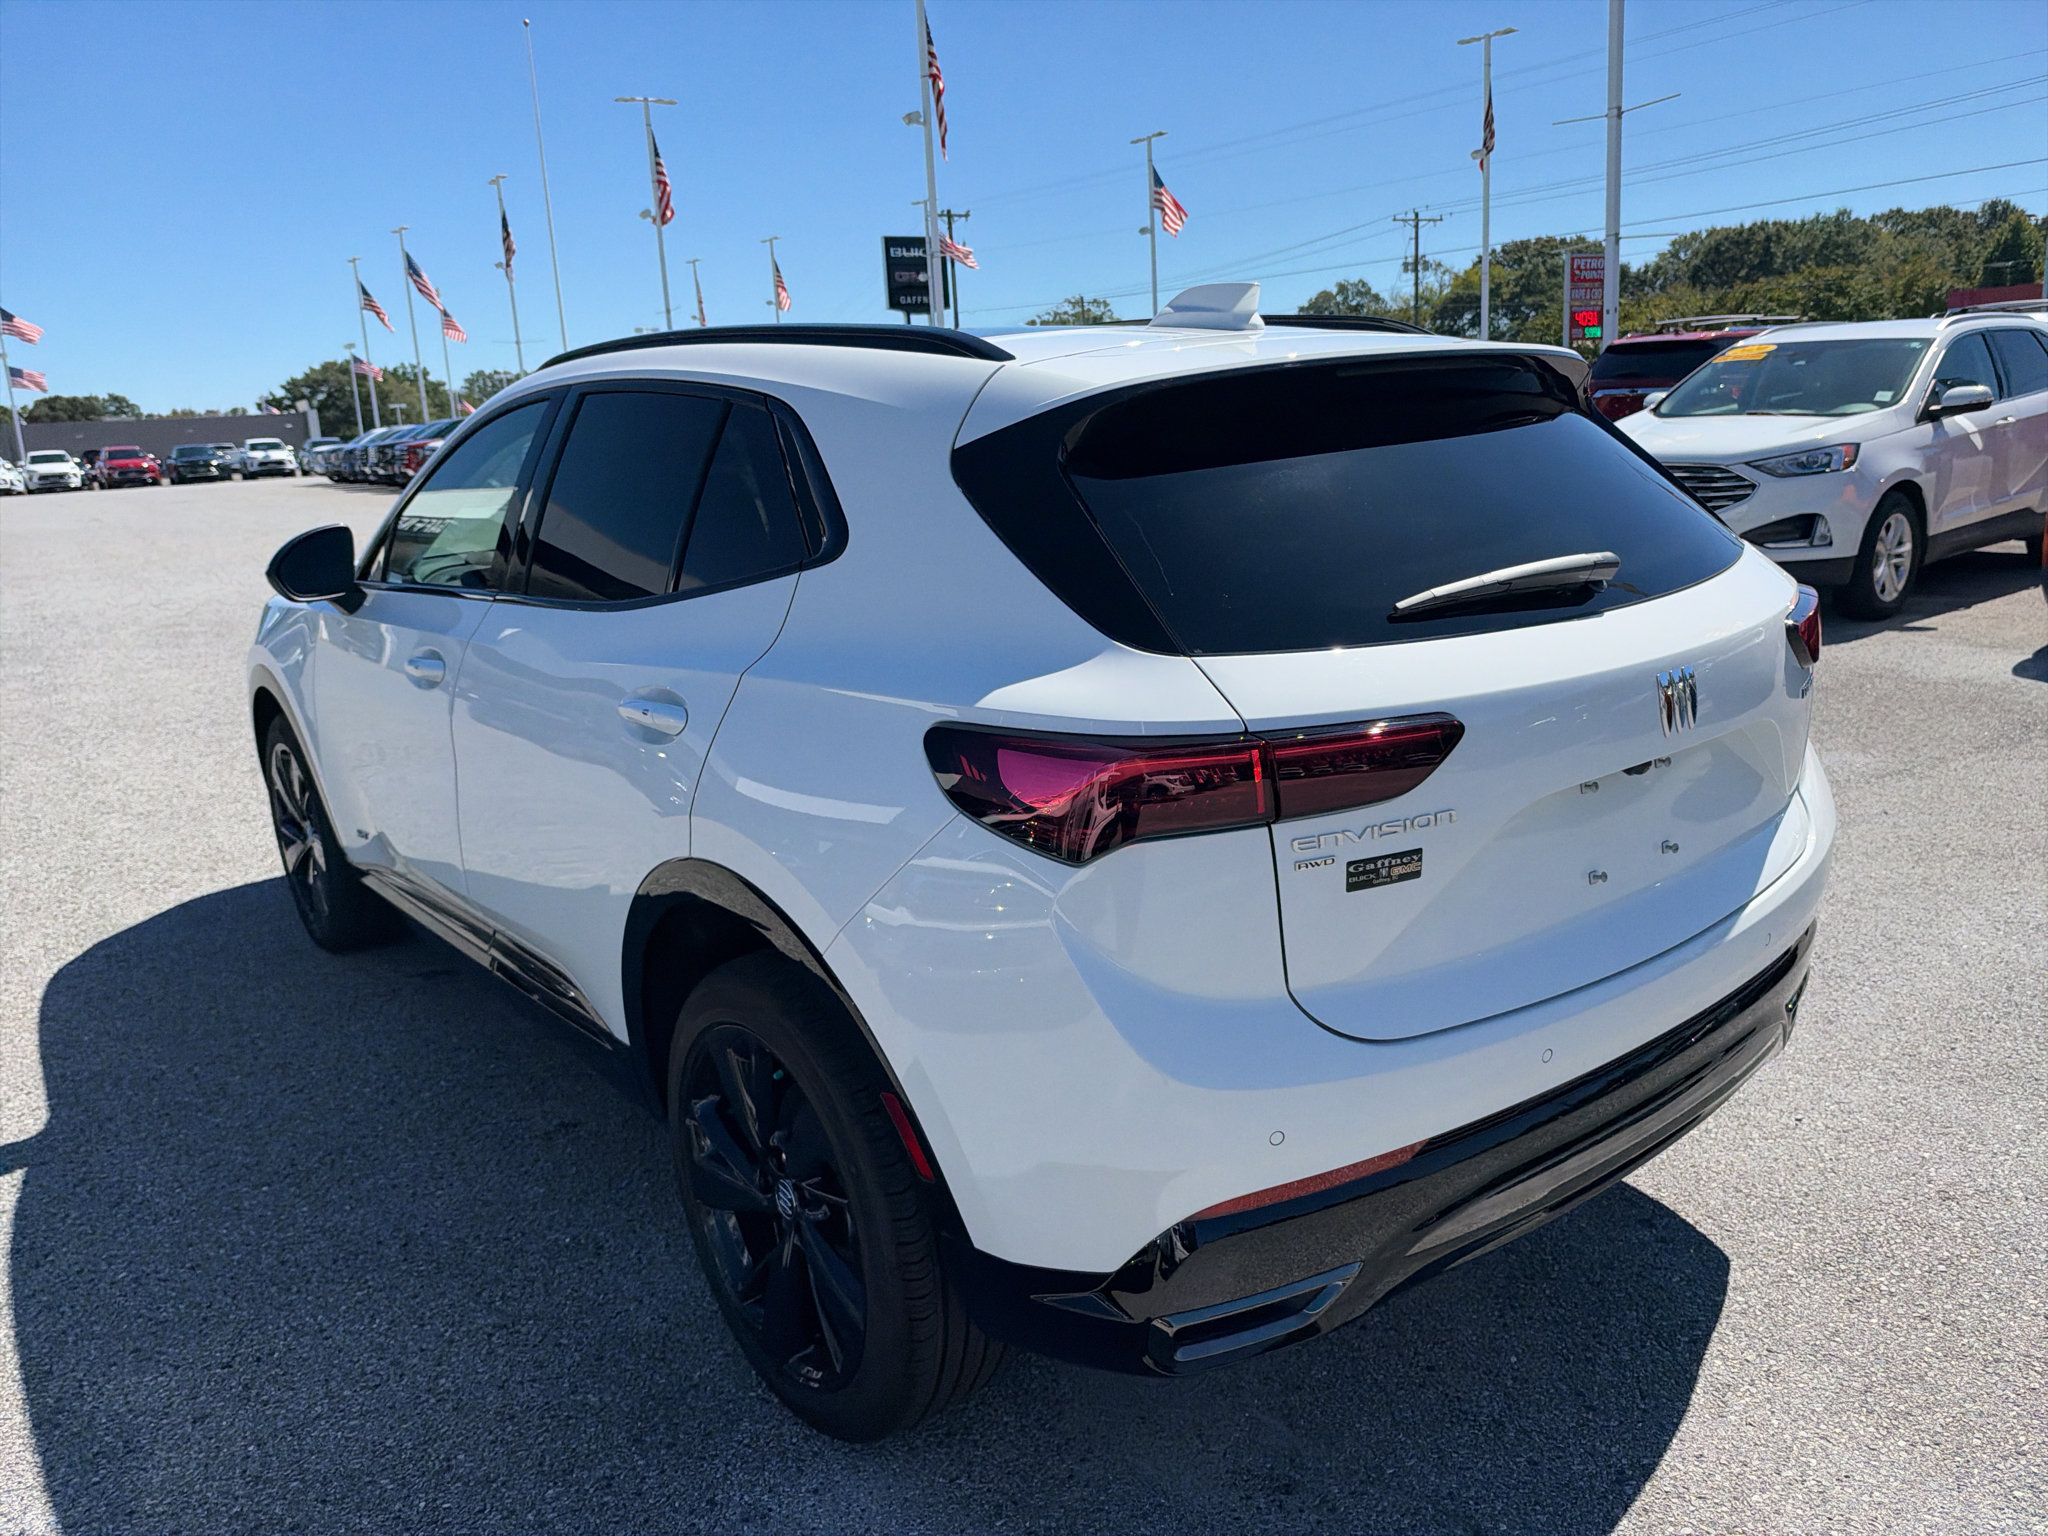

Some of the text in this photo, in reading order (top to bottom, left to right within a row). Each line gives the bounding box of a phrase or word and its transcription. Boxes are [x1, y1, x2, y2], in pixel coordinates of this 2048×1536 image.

[890, 247, 927, 257] BUIC
[1574, 258, 1604, 269] PETRO
[900, 296, 928, 304] GAFFN
[1291, 809, 1457, 853] ENVISION
[1296, 857, 1336, 871] AWD
[1348, 854, 1421, 873] Gaffney
[1348, 862, 1421, 883] BUICK GMC
